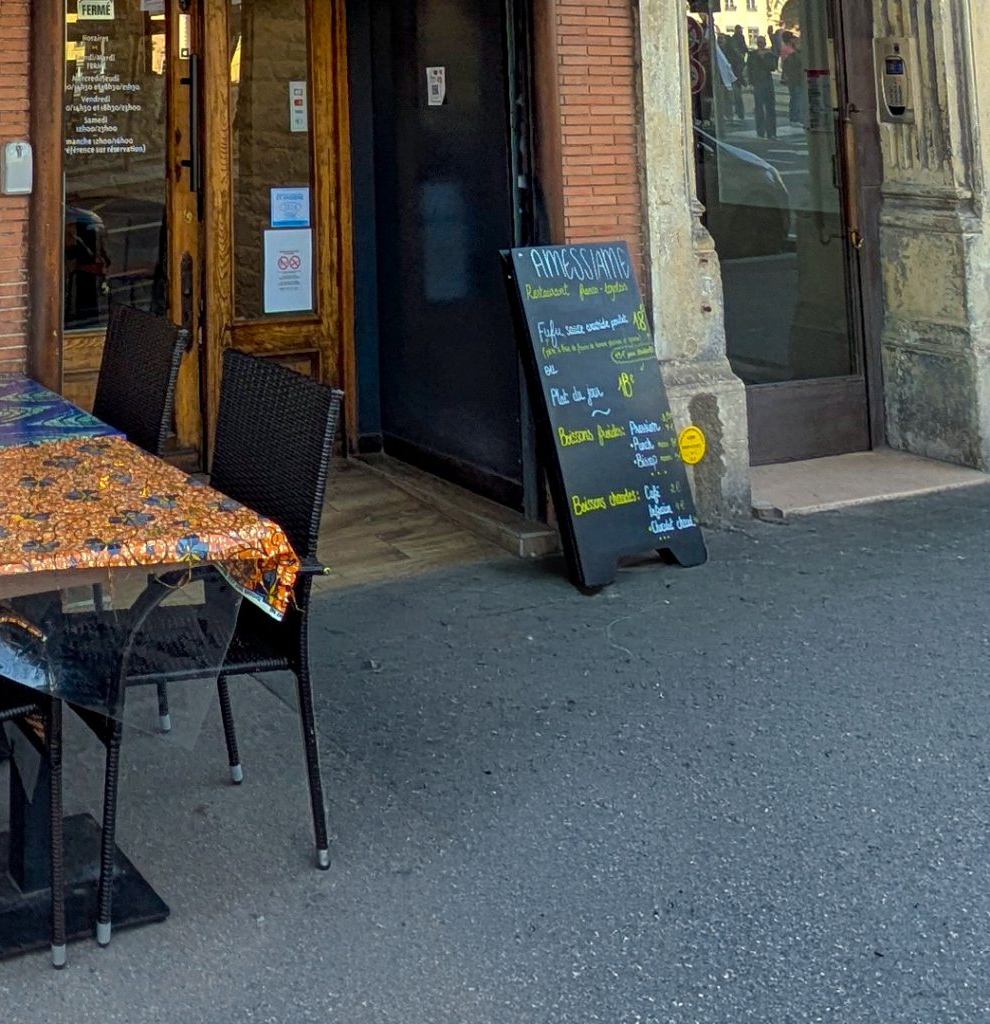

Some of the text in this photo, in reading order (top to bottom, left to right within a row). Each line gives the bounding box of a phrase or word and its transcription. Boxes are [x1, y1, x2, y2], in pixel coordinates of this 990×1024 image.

[81, 3, 111, 16] FERMÉ
[81, 95, 111, 103] Vendredi
[84, 116, 108, 124] Samedi
[530, 247, 630, 281] AMESSIAME
[537, 319, 564, 349] Fufu
[550, 386, 570, 407] Plat
[572, 385, 586, 402] du
